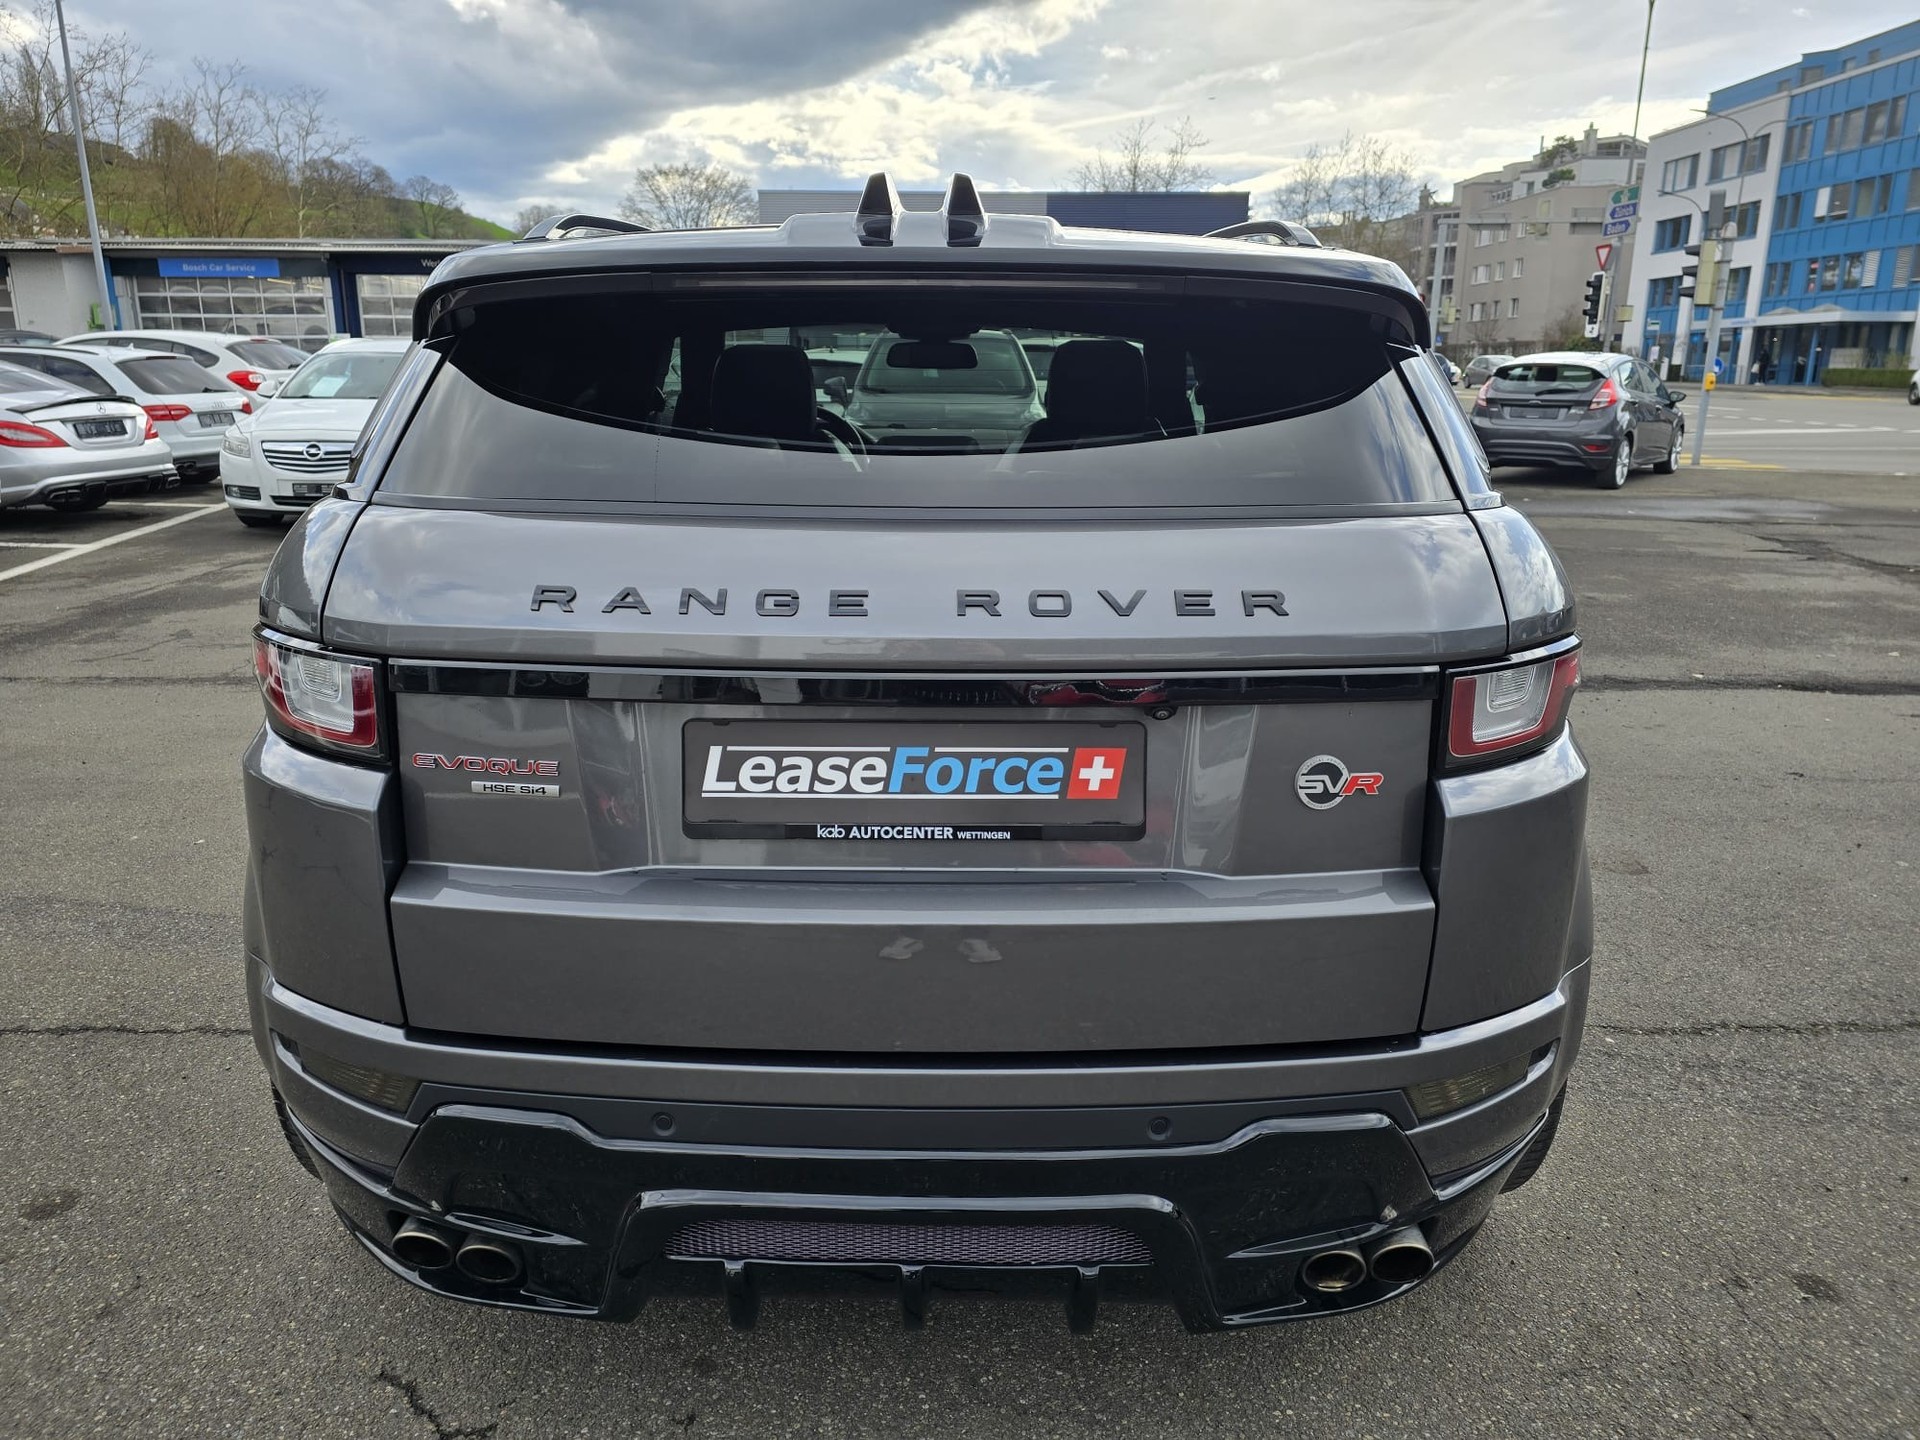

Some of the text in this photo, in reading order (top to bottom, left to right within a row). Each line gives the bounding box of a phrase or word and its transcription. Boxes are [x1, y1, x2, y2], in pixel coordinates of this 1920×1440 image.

[183, 264, 256, 272] Bosch Car Service
[531, 584, 1290, 618] RANGE ROVER
[412, 752, 559, 776] EVOQUE
[701, 745, 1064, 794] LeaseForce
[483, 783, 547, 796] HSE Si4
[816, 824, 1011, 840] kab AUTOCENTER WETTINGEN
